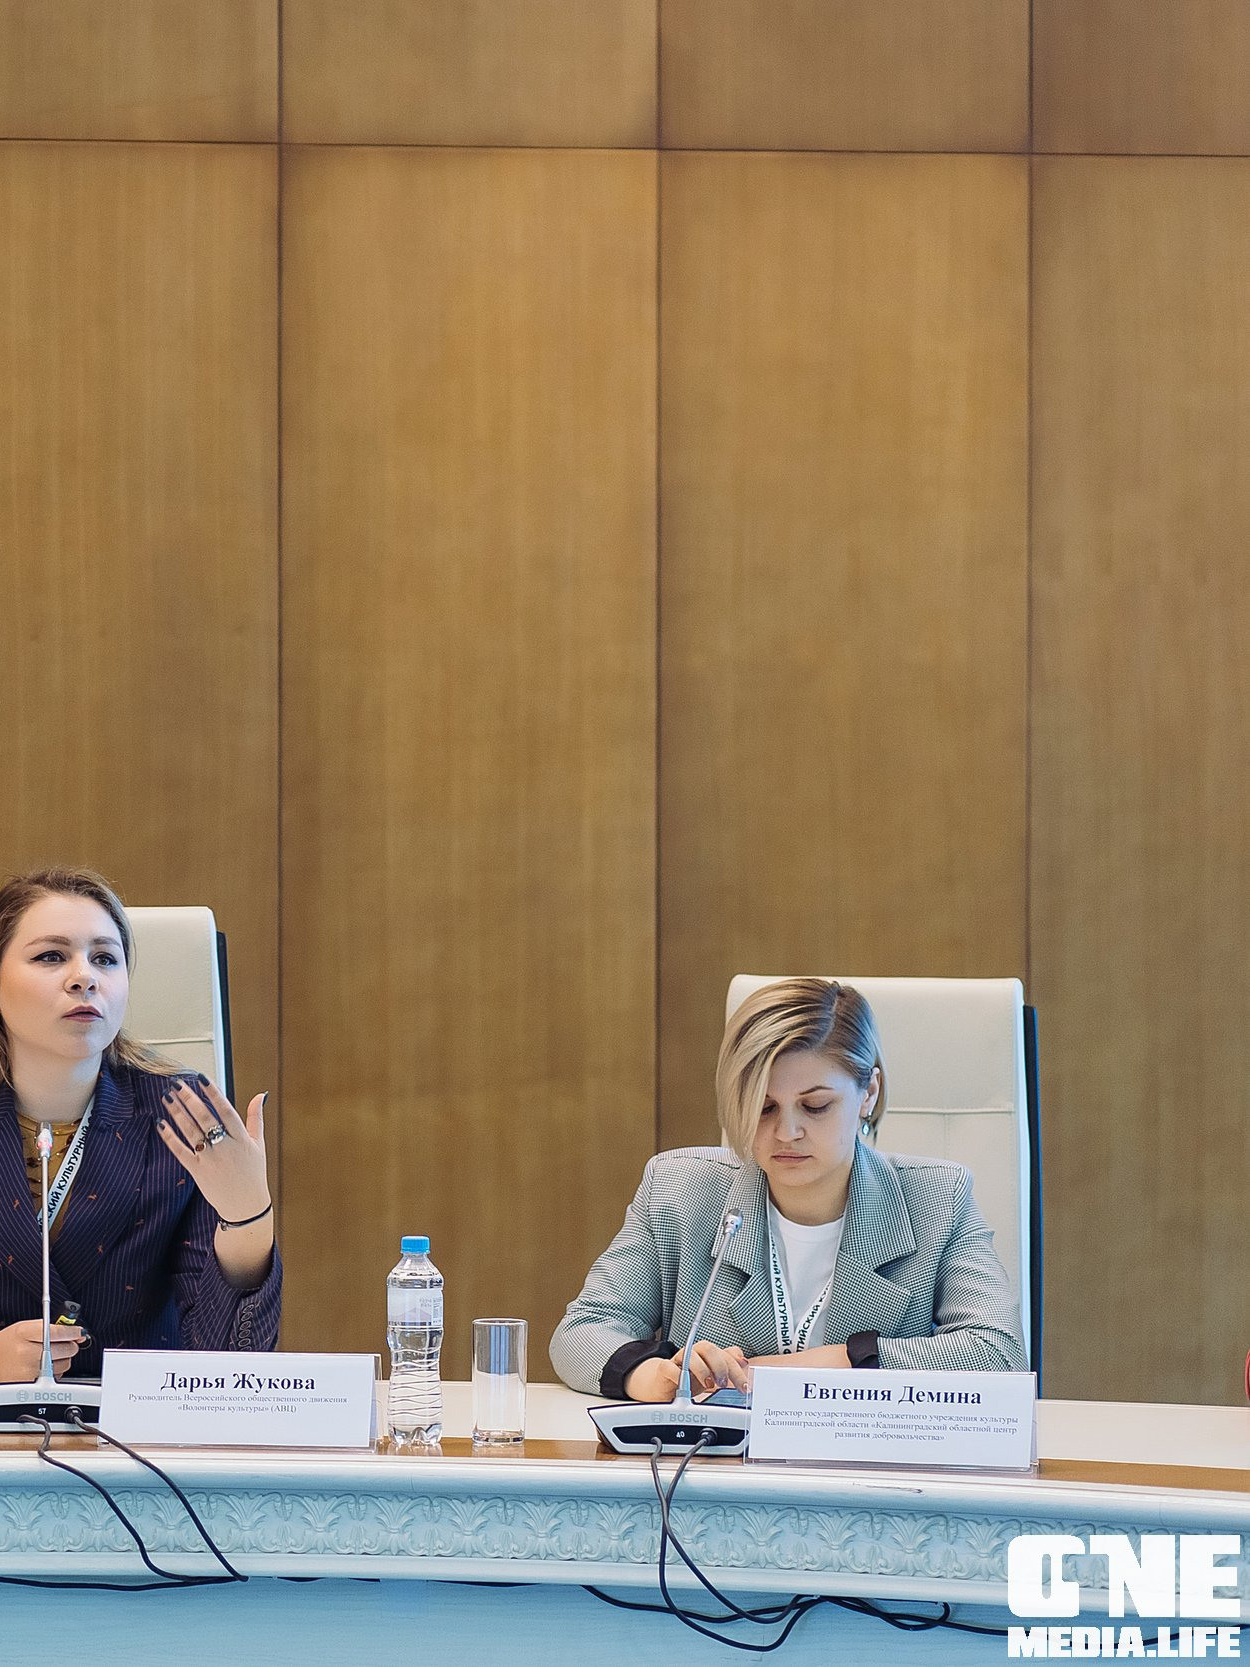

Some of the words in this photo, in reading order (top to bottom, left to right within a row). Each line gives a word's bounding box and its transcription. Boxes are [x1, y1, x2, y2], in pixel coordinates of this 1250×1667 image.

[57, 1126, 88, 1190] КУЛЬТУРНЫЙ
[774, 1277, 792, 1346] КУЛЬТУРНЫЙ
[160, 1373, 225, 1393] Дарья
[232, 1373, 316, 1394] Жукова
[34, 1392, 72, 1401] BOSCH
[128, 1393, 182, 1402] Руководитель
[184, 1393, 246, 1403] Всероссийского
[247, 1394, 307, 1403] общественного
[803, 1383, 892, 1402] Евгения
[897, 1386, 982, 1405] Демина
[177, 1403, 225, 1413] «Волонтеры
[227, 1405, 269, 1414] культуры»
[763, 1408, 803, 1418] Директор
[804, 1410, 876, 1419] государственного
[877, 1411, 928, 1420] бюджетного
[929, 1413, 978, 1422] учреждения
[979, 1415, 1019, 1424] культуры
[670, 1413, 708, 1423] BOSCH
[764, 1418, 836, 1428] Калининградской
[837, 1419, 869, 1428] области
[870, 1421, 948, 1431] «Калининградский
[949, 1423, 991, 1432] областной
[992, 1426, 1018, 1435] центр
[834, 1430, 870, 1439] развития
[872, 1431, 945, 1441] добровольчества»
